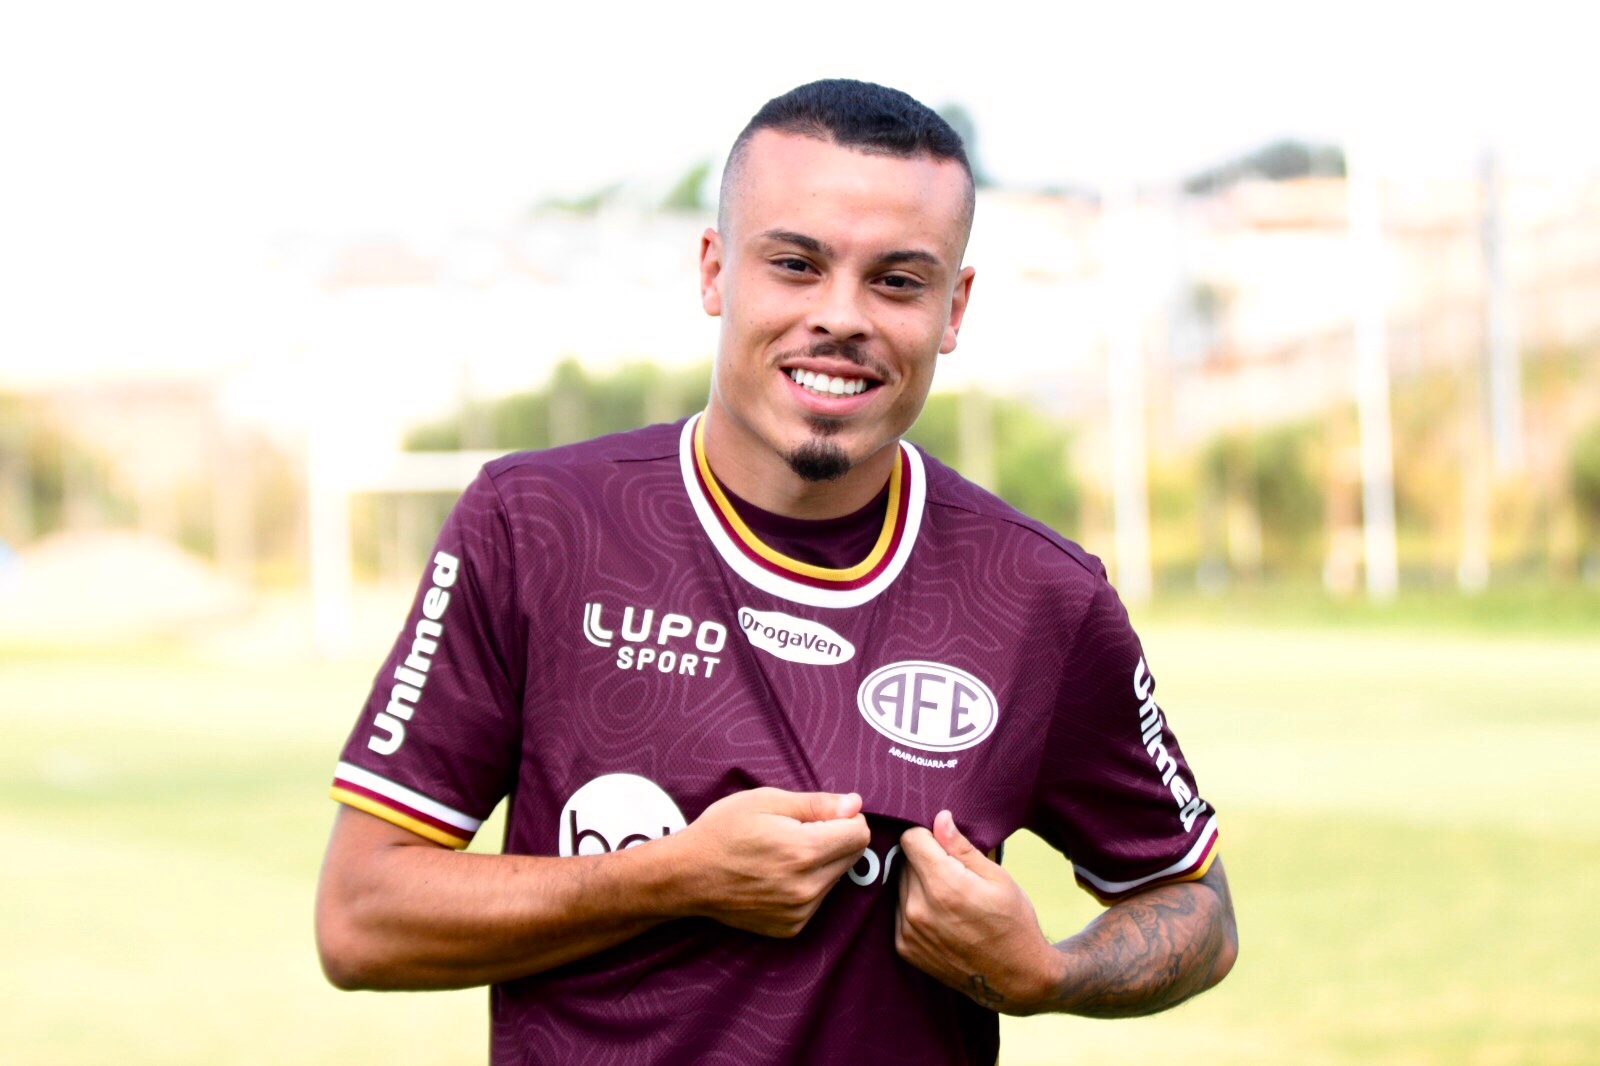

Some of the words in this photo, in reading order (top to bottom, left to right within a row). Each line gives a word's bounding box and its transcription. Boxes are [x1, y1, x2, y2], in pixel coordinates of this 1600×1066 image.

[367, 551, 459, 755] Unimed
[583, 603, 728, 653] LUPO
[741, 611, 842, 658] DrogaVen
[616, 646, 720, 678] SPORT
[871, 672, 980, 738] AFE
[888, 747, 958, 768] ARARAQUARA-SP
[1134, 656, 1207, 832] Unimed
